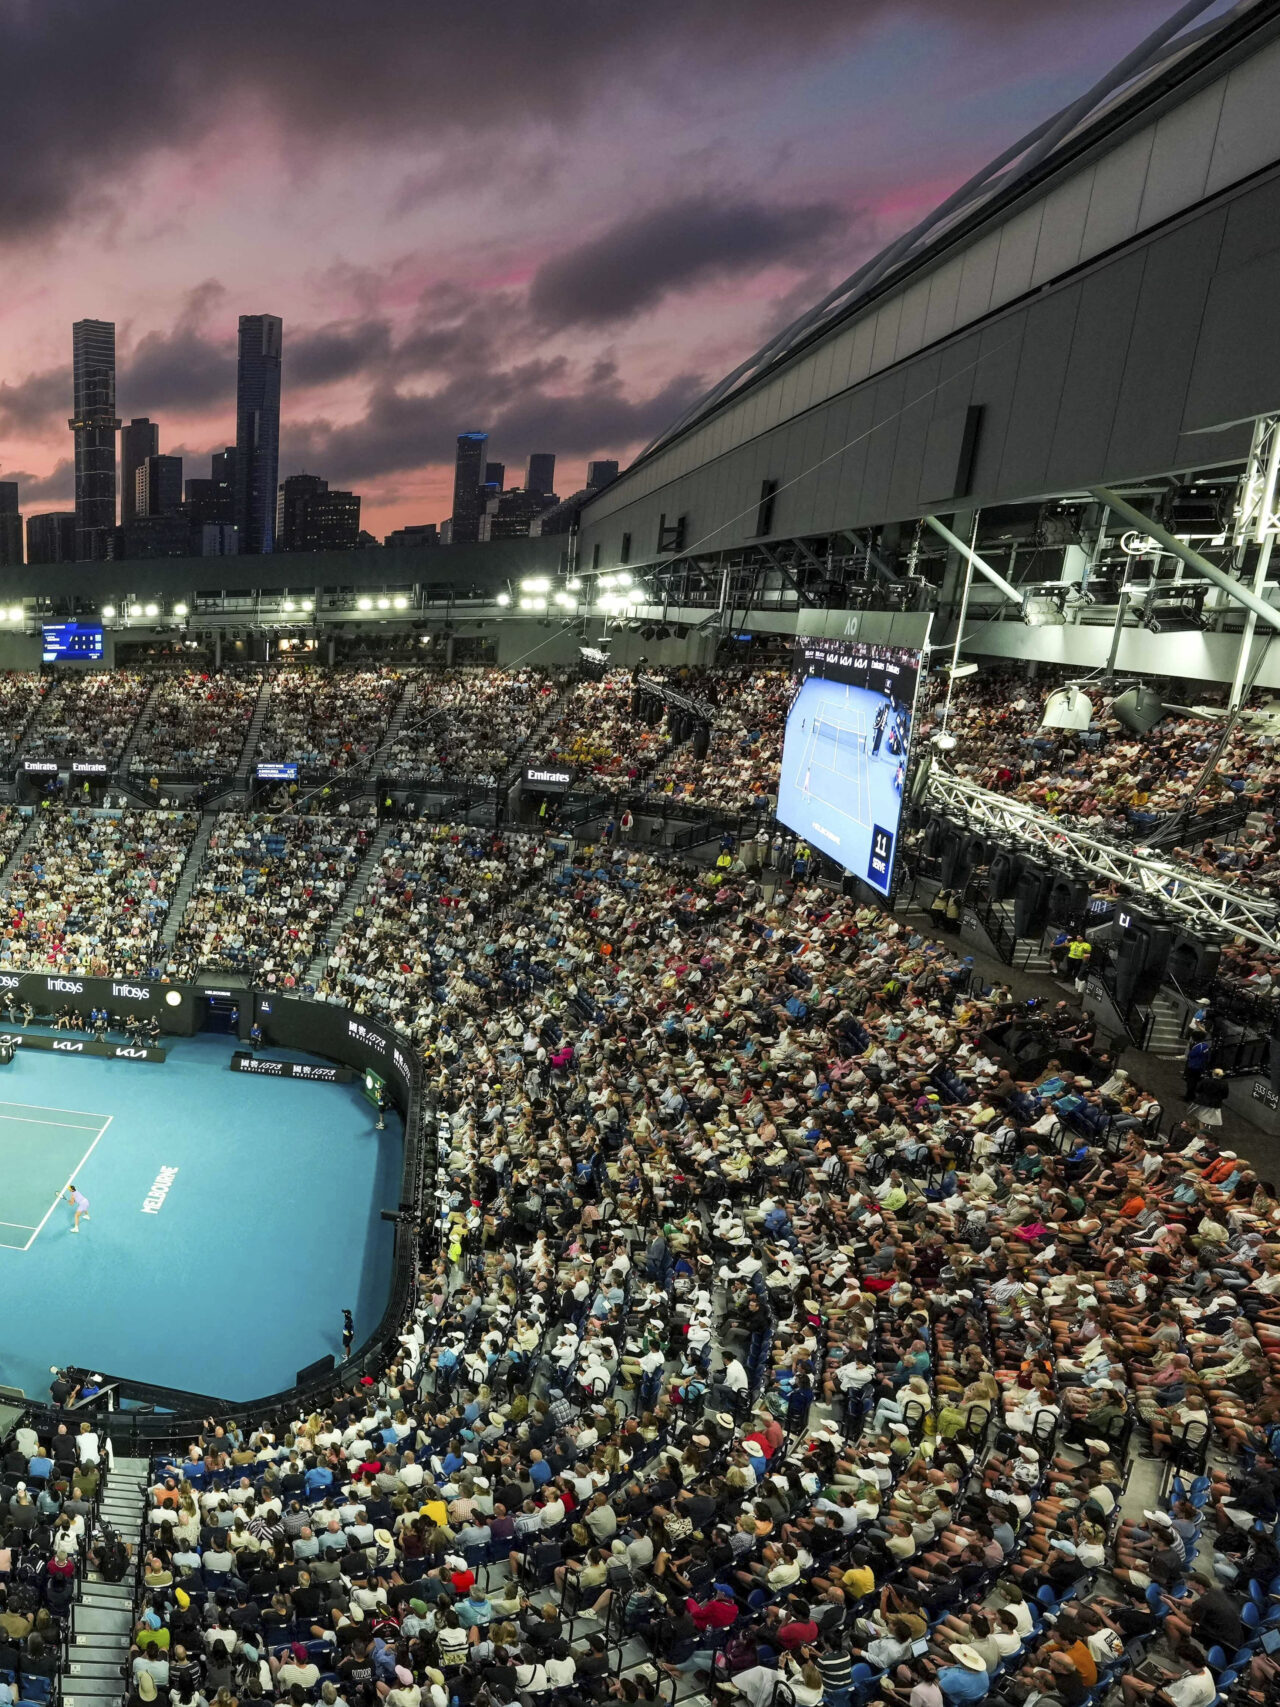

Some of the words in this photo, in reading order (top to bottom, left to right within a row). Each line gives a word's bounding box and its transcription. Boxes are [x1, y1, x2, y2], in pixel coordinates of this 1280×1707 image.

[24, 762, 58, 770] Emirates
[72, 762, 106, 771] Emirates
[528, 770, 570, 782] Emirates
[875, 834, 886, 857] 11
[872, 857, 886, 874] SERVE
[48, 978, 84, 994] Infosys
[112, 983, 150, 1000] Infosys
[1254, 1082, 1266, 1094] 533
[1266, 1090, 1278, 1102] 534
[140, 1165, 179, 1214] MELBOURNE
